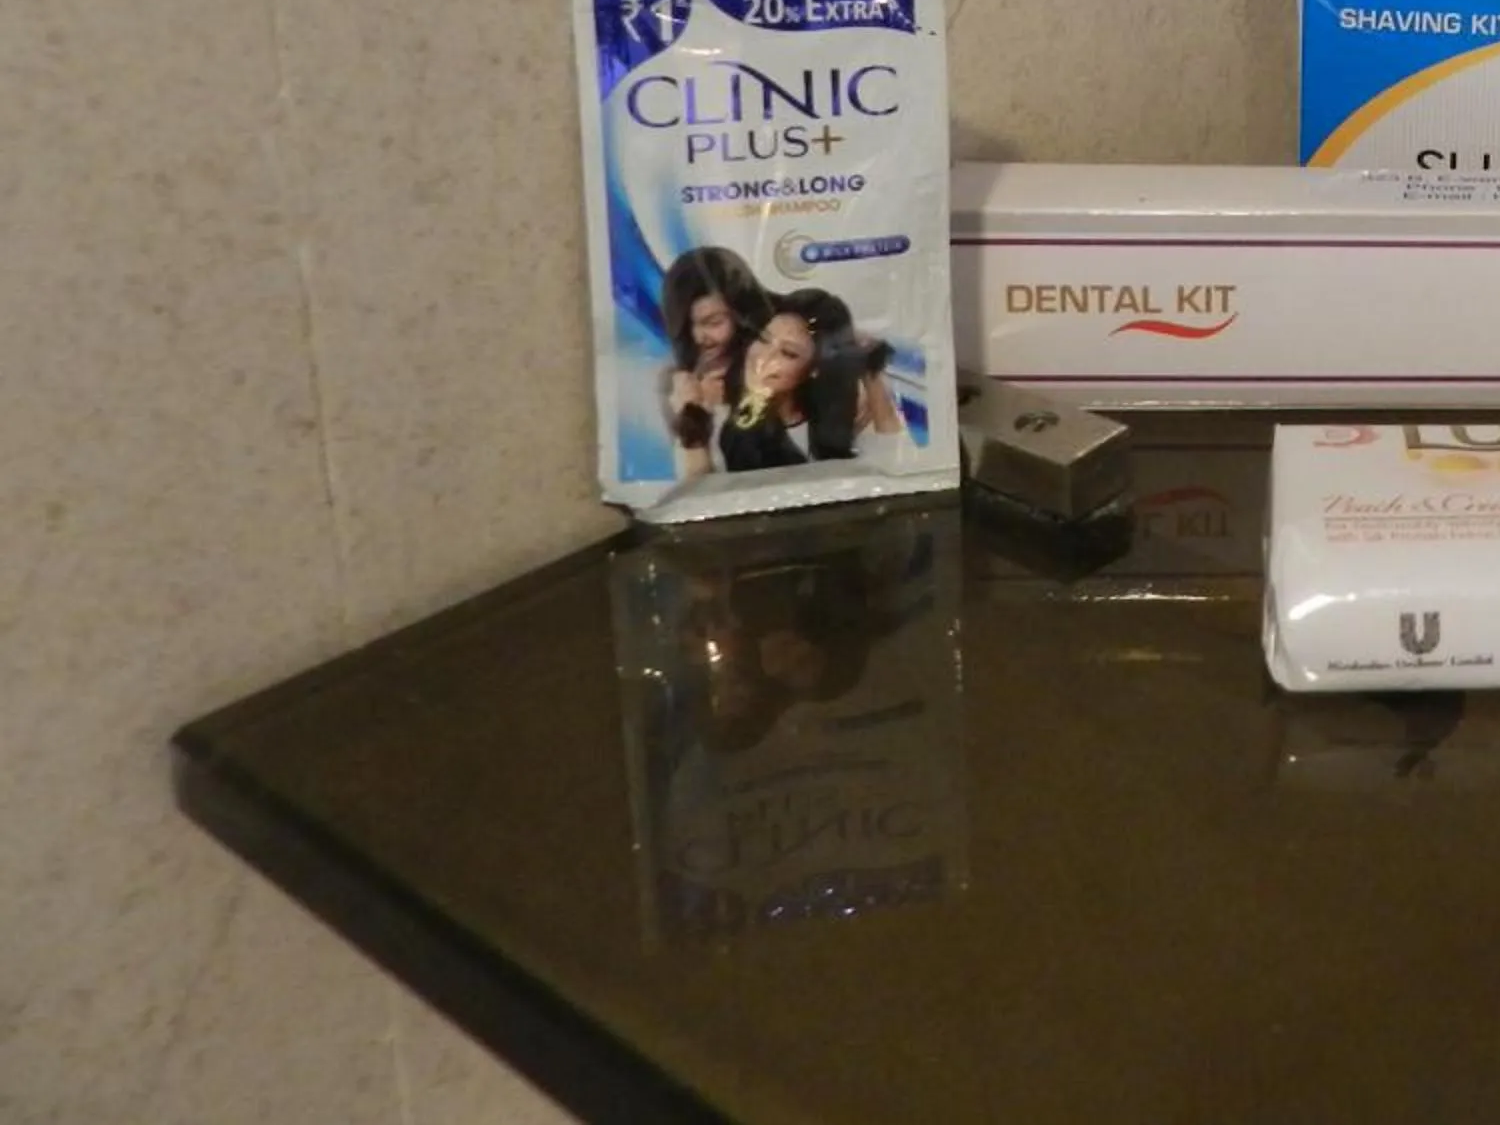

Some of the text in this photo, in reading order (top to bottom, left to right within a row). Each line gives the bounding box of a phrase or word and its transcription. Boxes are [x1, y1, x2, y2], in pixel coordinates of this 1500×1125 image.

[1338, 7, 1462, 35] SHAVING
[625, 59, 899, 129] CLINIC
[1005, 284, 1238, 314] DENTAL KIT
